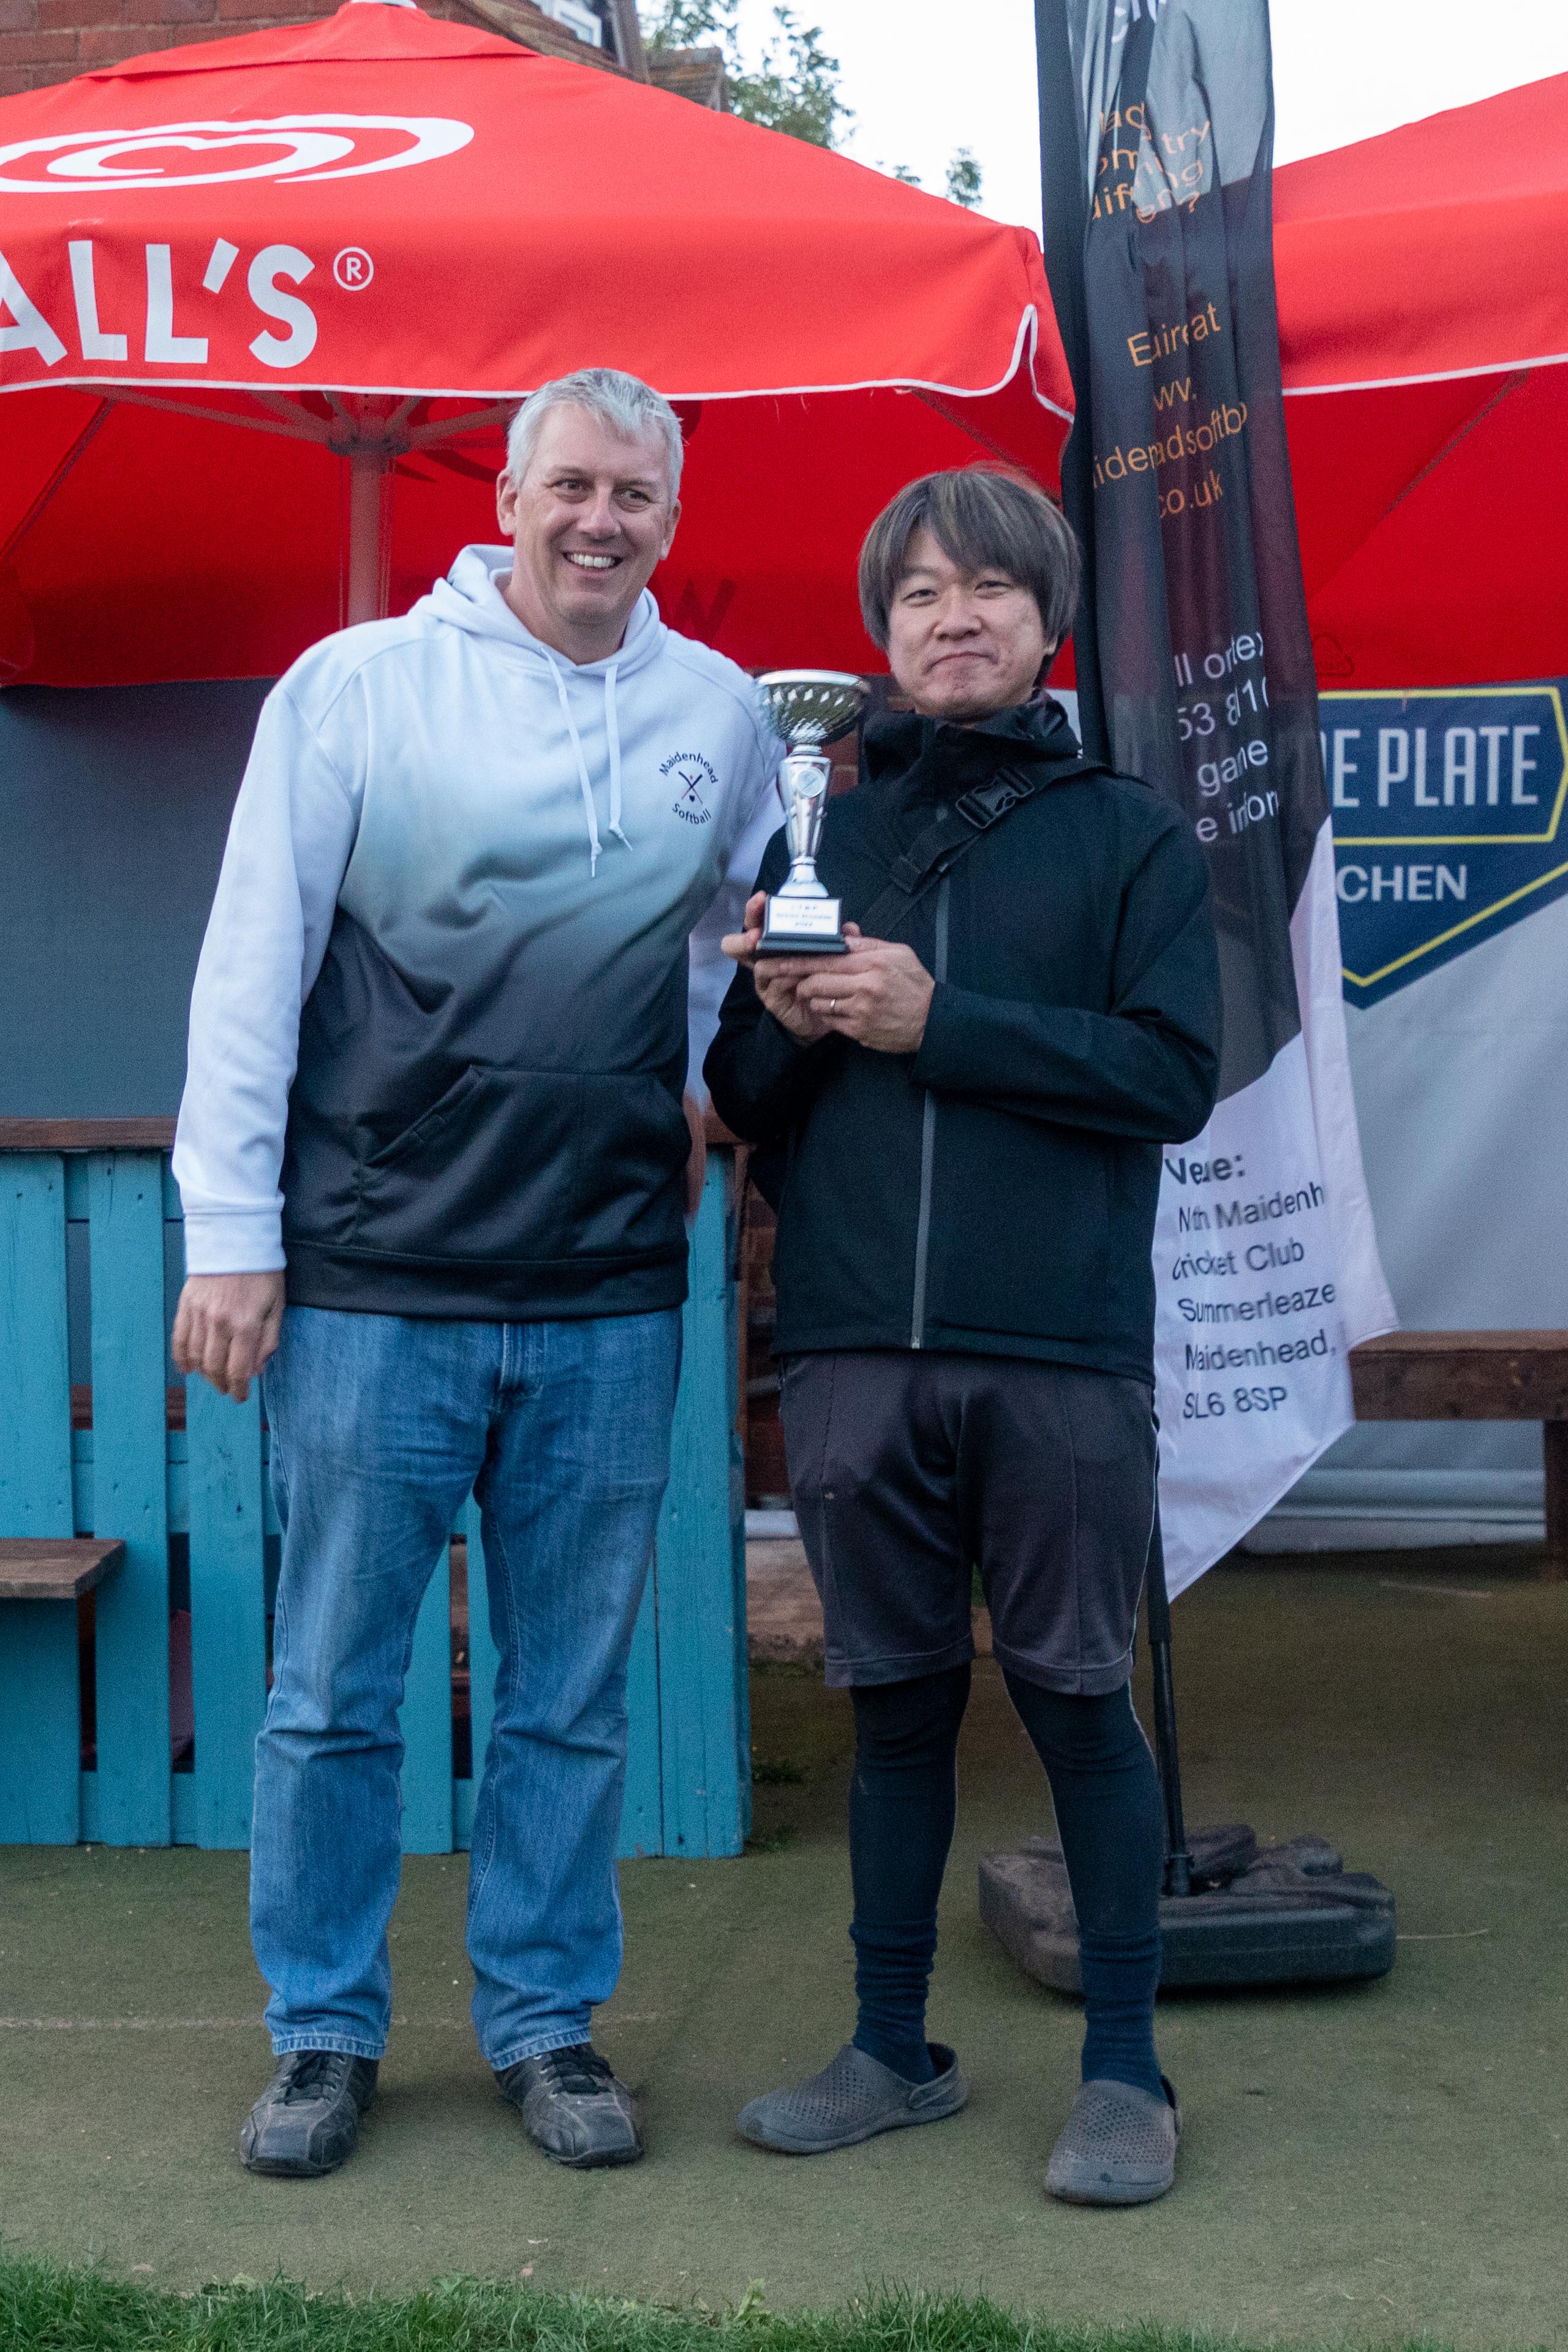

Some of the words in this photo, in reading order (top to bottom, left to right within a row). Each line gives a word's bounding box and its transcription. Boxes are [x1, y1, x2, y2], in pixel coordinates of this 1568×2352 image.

[659, 752, 718, 784] Maidenhead
[1378, 726, 1540, 807] PLATE
[673, 803, 712, 825] Softball
[1336, 864, 1468, 903] CHEN
[1245, 1237, 1305, 1272] Club
[1177, 1283, 1336, 1322] Summerleaze
[1183, 1392, 1226, 1419] SL6
[1233, 1386, 1288, 1413] 8SP
